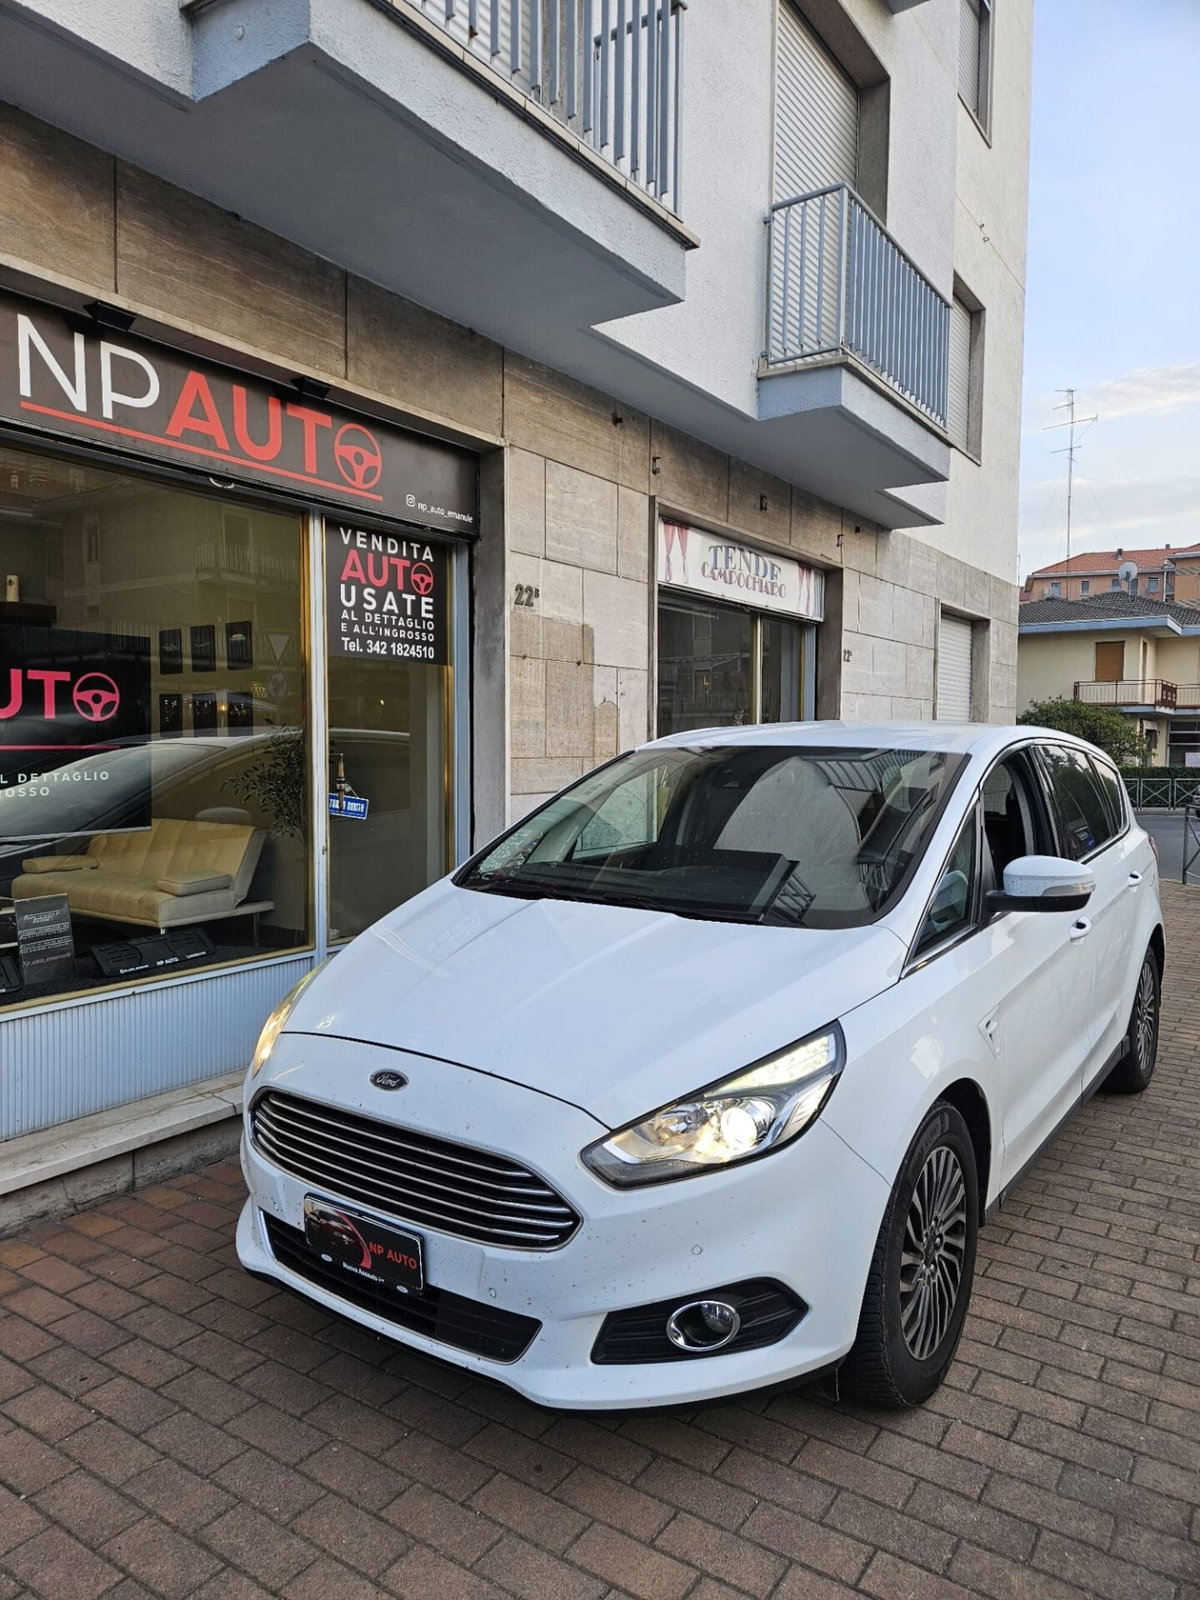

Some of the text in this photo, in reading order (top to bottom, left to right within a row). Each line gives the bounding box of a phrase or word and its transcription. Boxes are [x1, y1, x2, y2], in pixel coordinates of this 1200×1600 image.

[340, 526, 434, 562] VENDITA
[340, 583, 434, 619] USATE
[341, 609, 435, 631] AL DETTAGLIO
[341, 622, 435, 642] E ALL'INGROSSO
[341, 636, 435, 659] Tel. 342 1824510
[18, 771, 110, 783] DETTAGLIO
[0, 786, 50, 798] OSSO
[369, 1241, 418, 1270] NP AUTO
